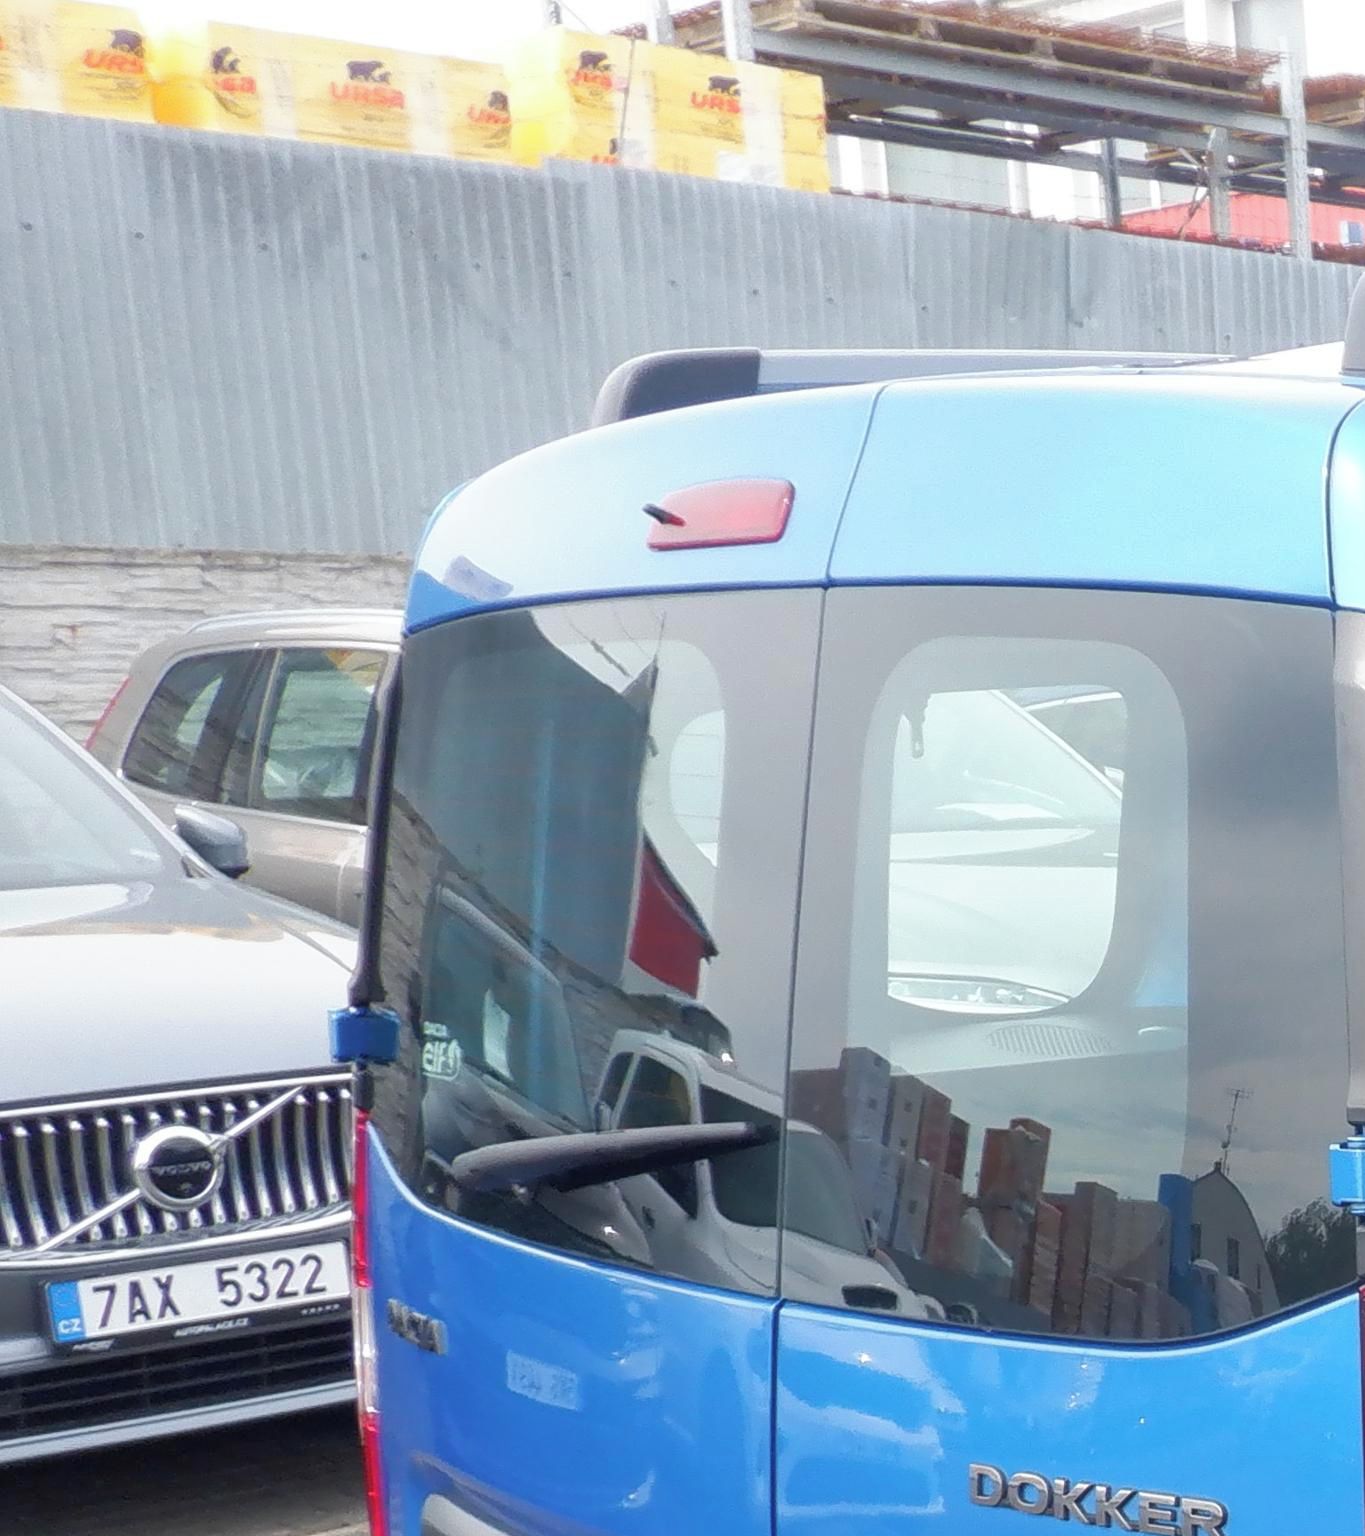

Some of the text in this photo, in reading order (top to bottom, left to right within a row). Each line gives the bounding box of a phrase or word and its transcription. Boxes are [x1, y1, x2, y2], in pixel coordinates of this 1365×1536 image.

[691, 91, 741, 114] URS
[92, 1253, 327, 1330] 7AX 5322
[58, 1318, 81, 1334] CZ
